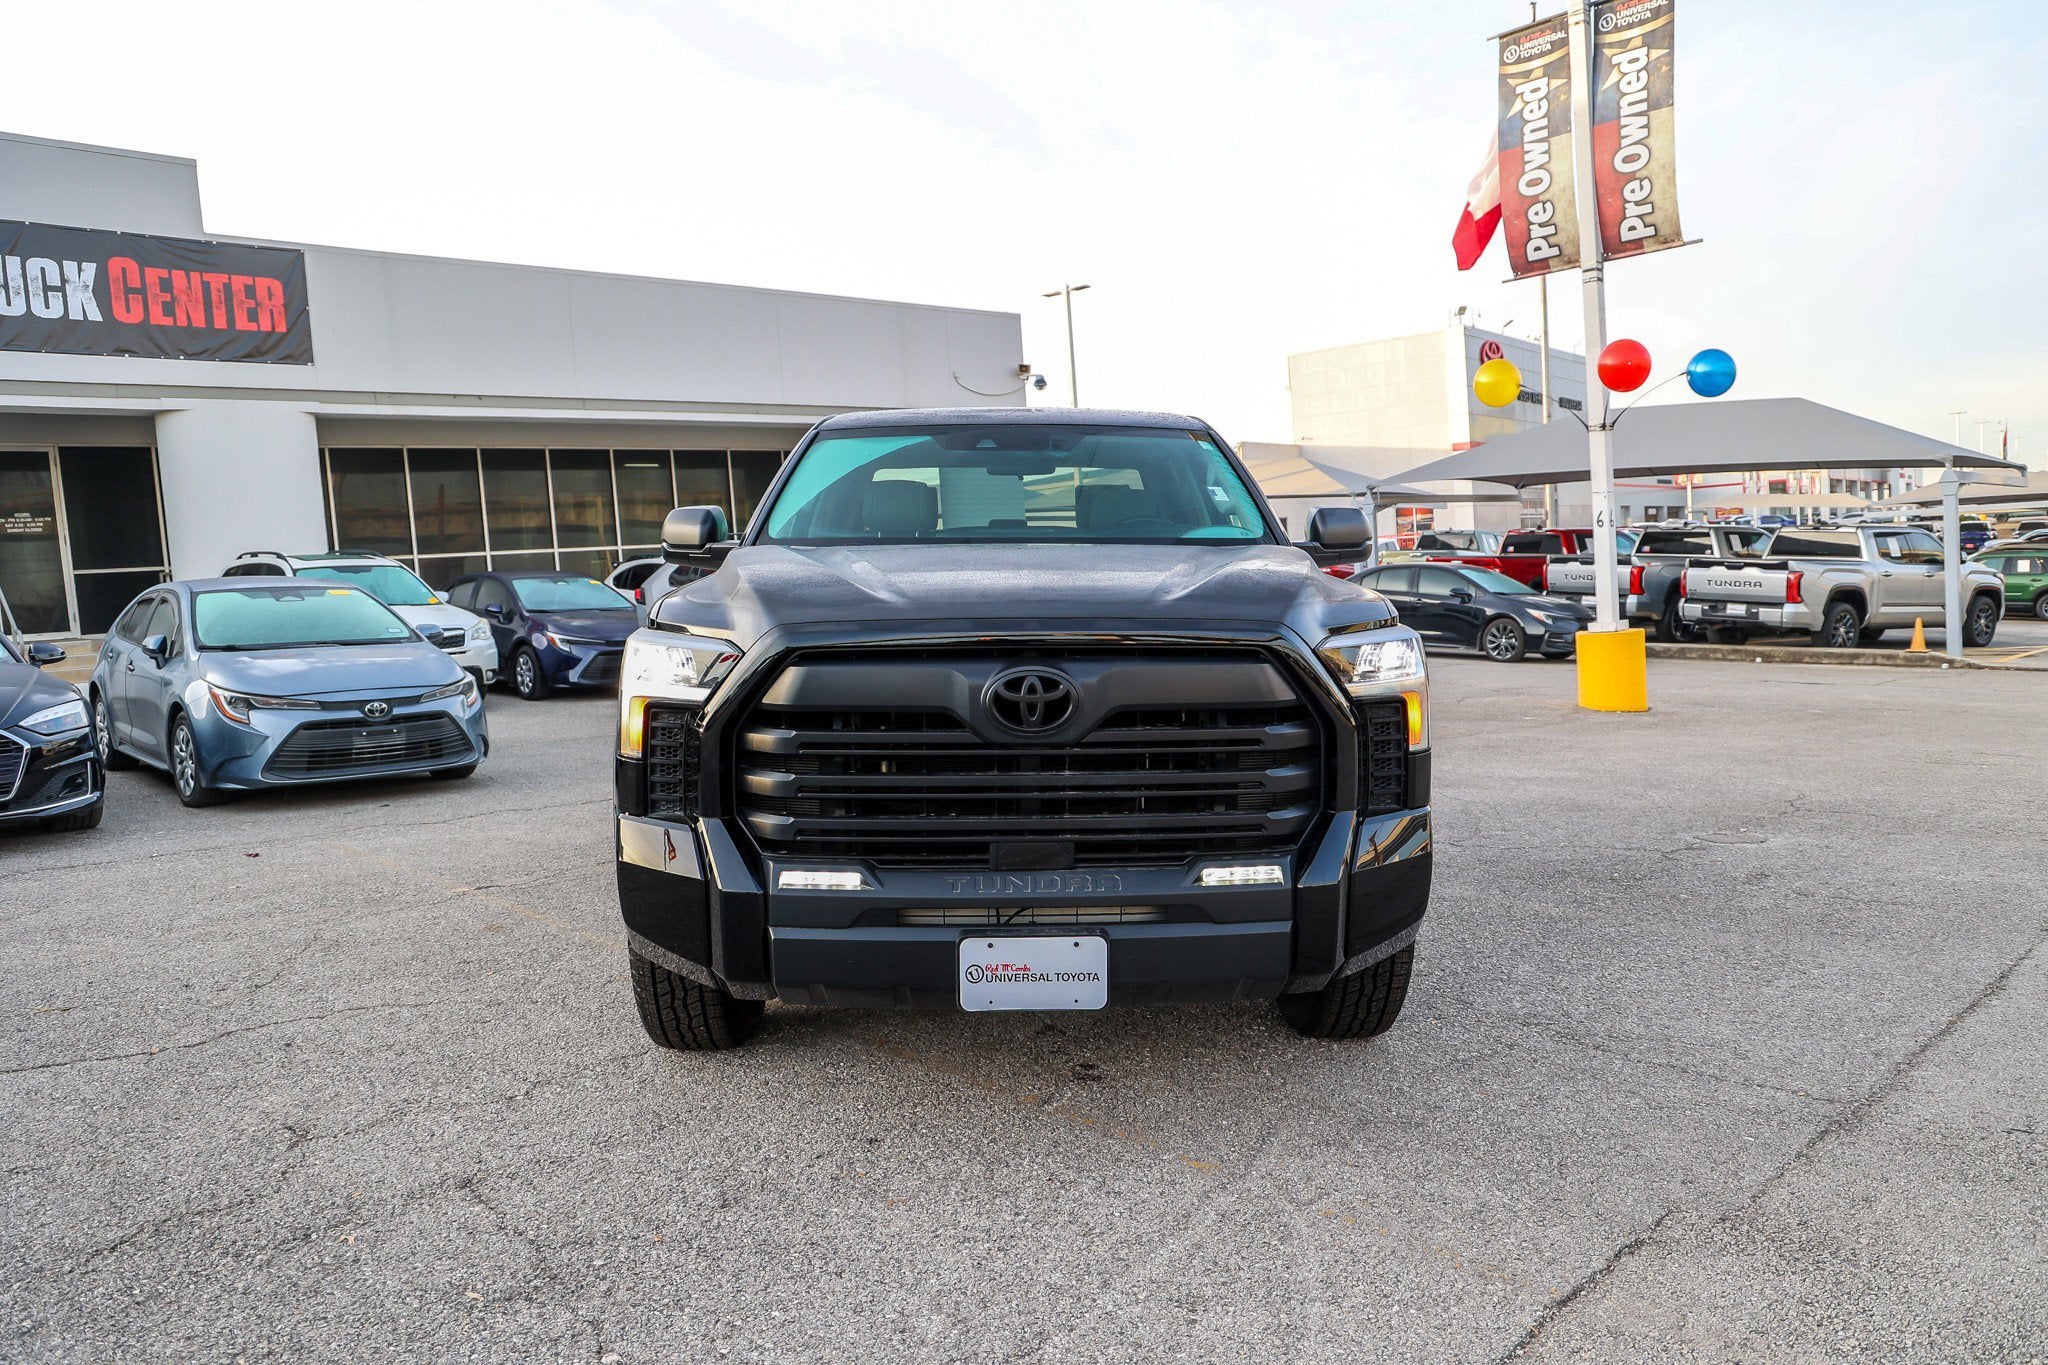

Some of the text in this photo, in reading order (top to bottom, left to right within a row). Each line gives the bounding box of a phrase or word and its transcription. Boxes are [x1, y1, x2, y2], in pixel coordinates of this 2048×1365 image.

[1616, 0, 1668, 19] UNIVERSAL
[1616, 10, 1651, 27] TOYOTA
[1520, 30, 1567, 51] UNIVERSAL
[1520, 43, 1551, 58] TOYOTA
[1611, 46, 1650, 173] Owned
[1516, 76, 1552, 197] Owned
[1620, 177, 1657, 242] Pre
[1526, 201, 1561, 262] Pre
[107, 256, 287, 333] CENTER
[1597, 510, 1604, 528] 6
[1706, 579, 1763, 589] TUNDRA
[943, 874, 1122, 893] TUNDRA
[985, 963, 999, 975] Red
[985, 972, 1100, 983] UNIVERSAL TOYOTA
